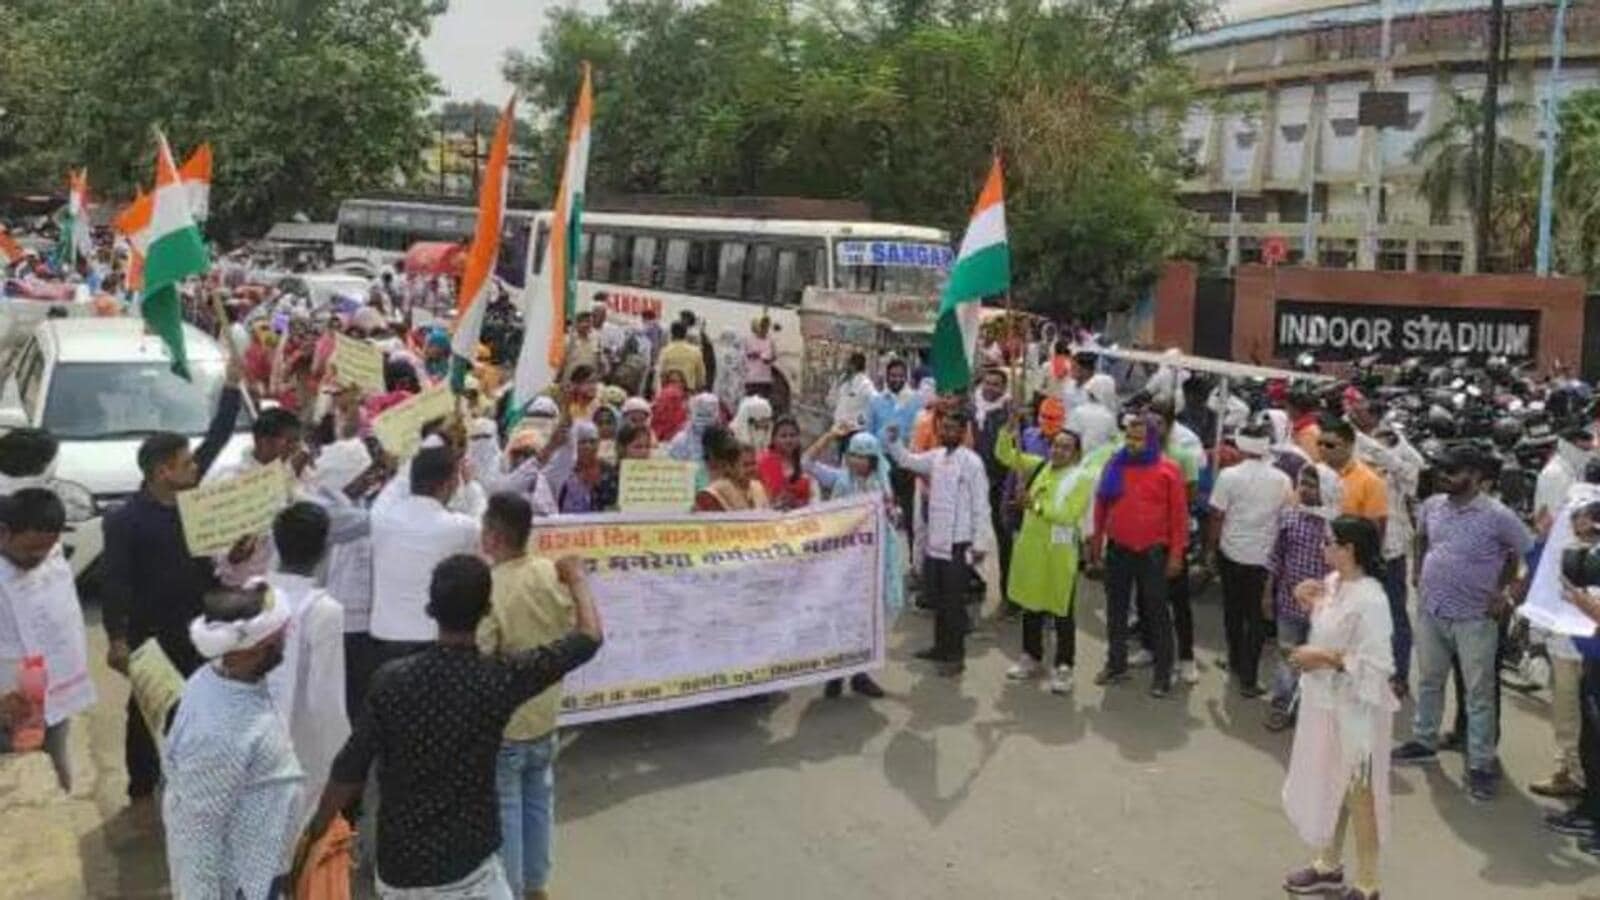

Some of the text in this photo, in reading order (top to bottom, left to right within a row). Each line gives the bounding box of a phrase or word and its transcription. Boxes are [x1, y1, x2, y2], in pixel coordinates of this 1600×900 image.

[1279, 313, 1530, 354] INDOOR STADIUM
[609, 552, 693, 571] मनरेगा
